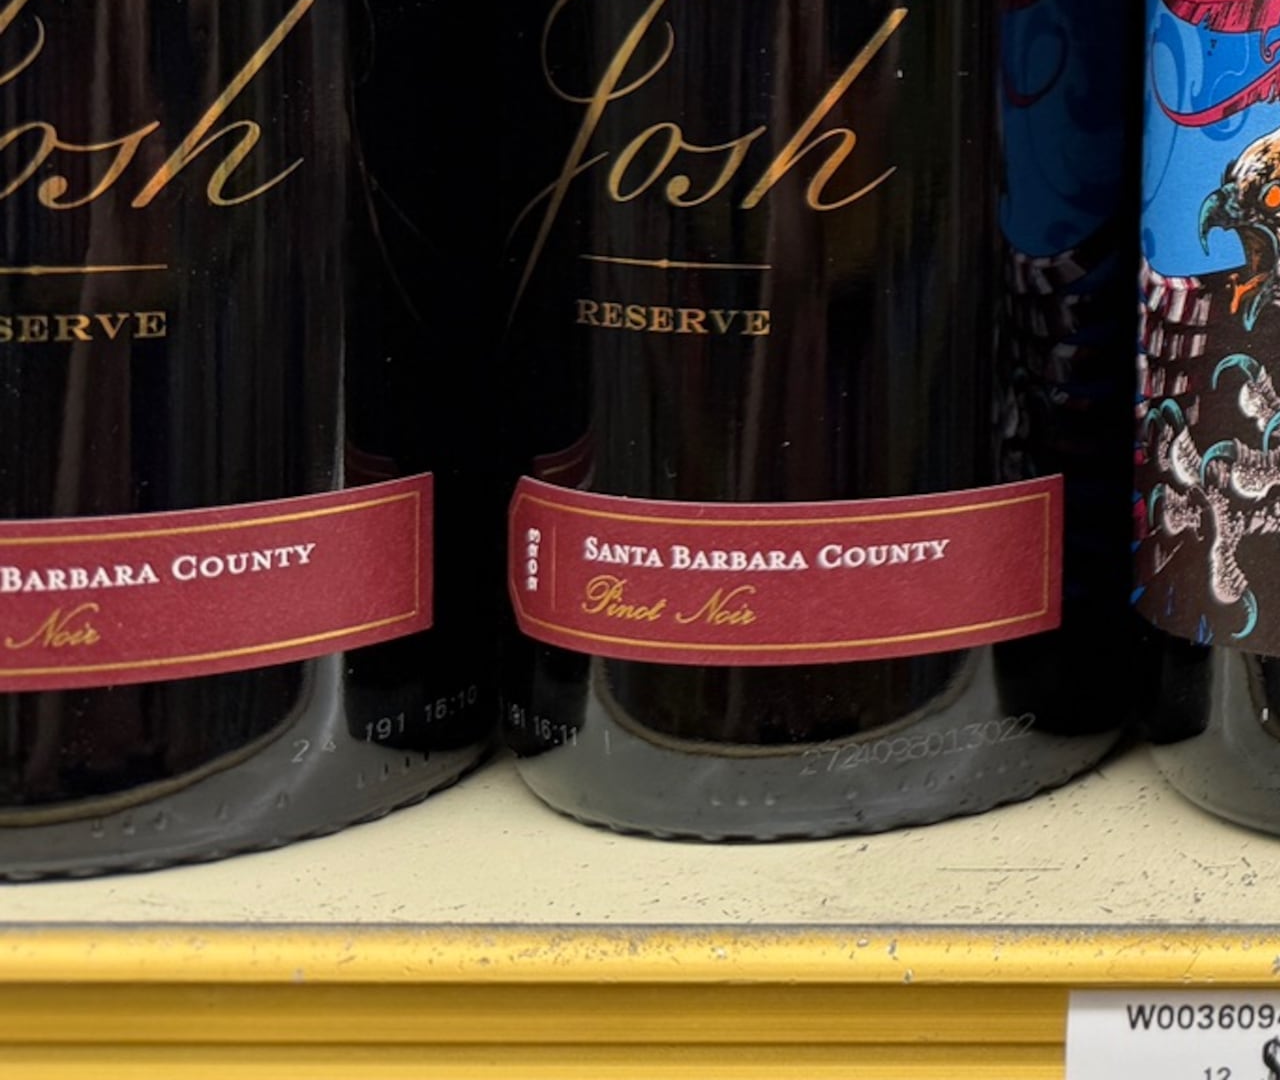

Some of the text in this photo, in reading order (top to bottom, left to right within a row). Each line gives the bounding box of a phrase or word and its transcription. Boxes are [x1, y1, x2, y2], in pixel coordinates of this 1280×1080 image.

[575, 298, 772, 337] RESERVE
[171, 542, 316, 582] COUNTY
[584, 536, 951, 571] SANTA BARBARA COUNTY
[582, 573, 758, 626] Pinot Noir
[5, 602, 101, 649] Noir
